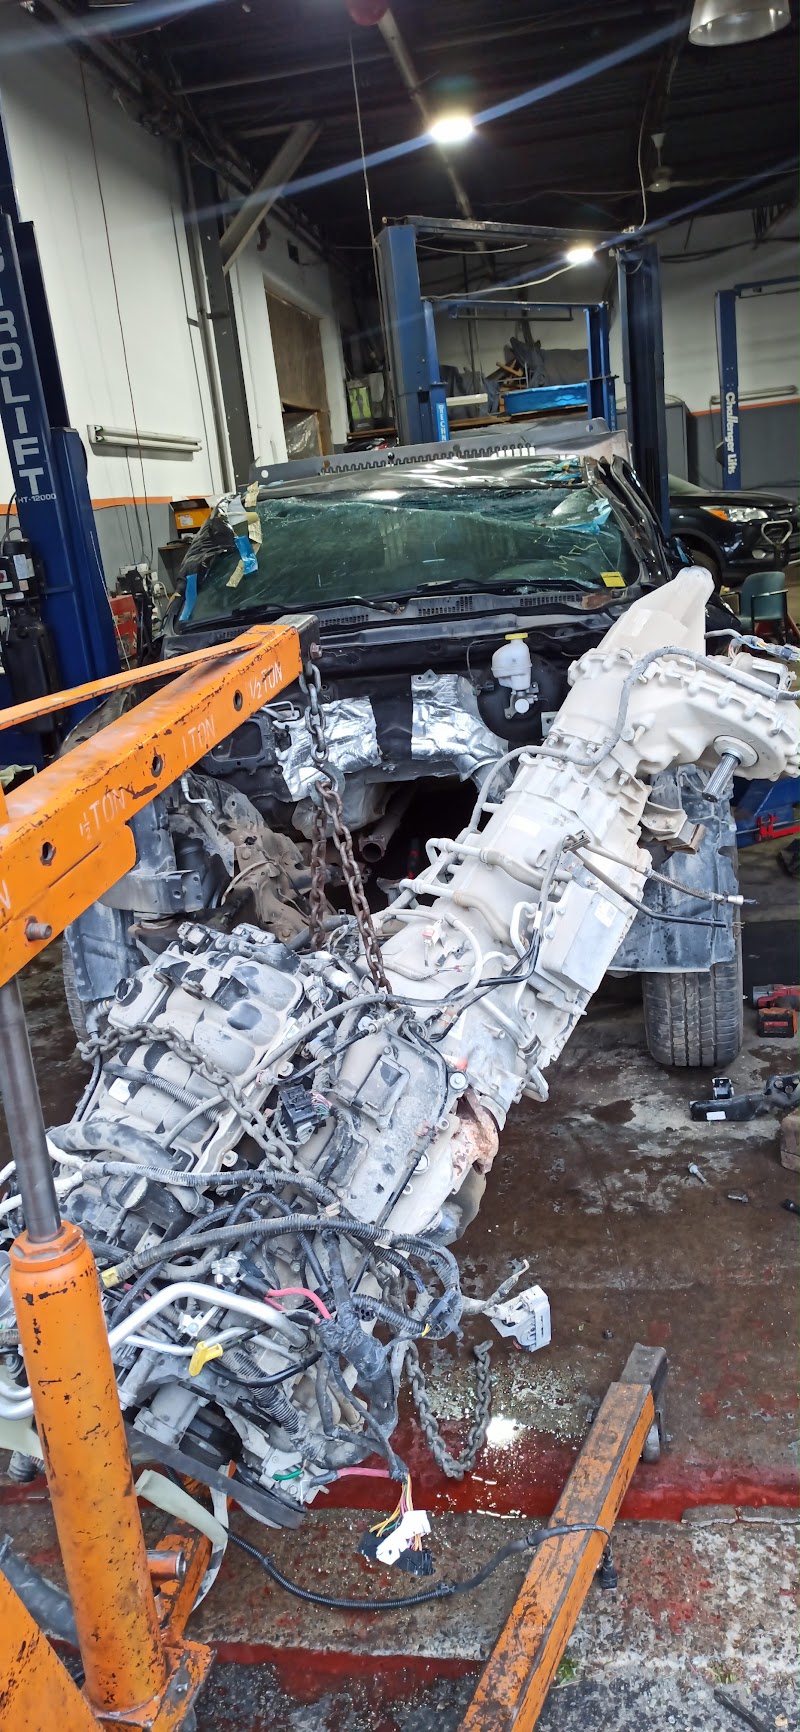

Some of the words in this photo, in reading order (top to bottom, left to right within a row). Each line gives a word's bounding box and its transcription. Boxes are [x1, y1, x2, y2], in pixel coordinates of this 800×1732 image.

[0, 246, 44, 496] ROLIFT
[725, 391, 739, 453] Challenger
[18, 493, 57, 503] HT-12000
[261, 661, 283, 693] TON
[187, 714, 216, 753] TON
[89, 783, 126, 831] TON
